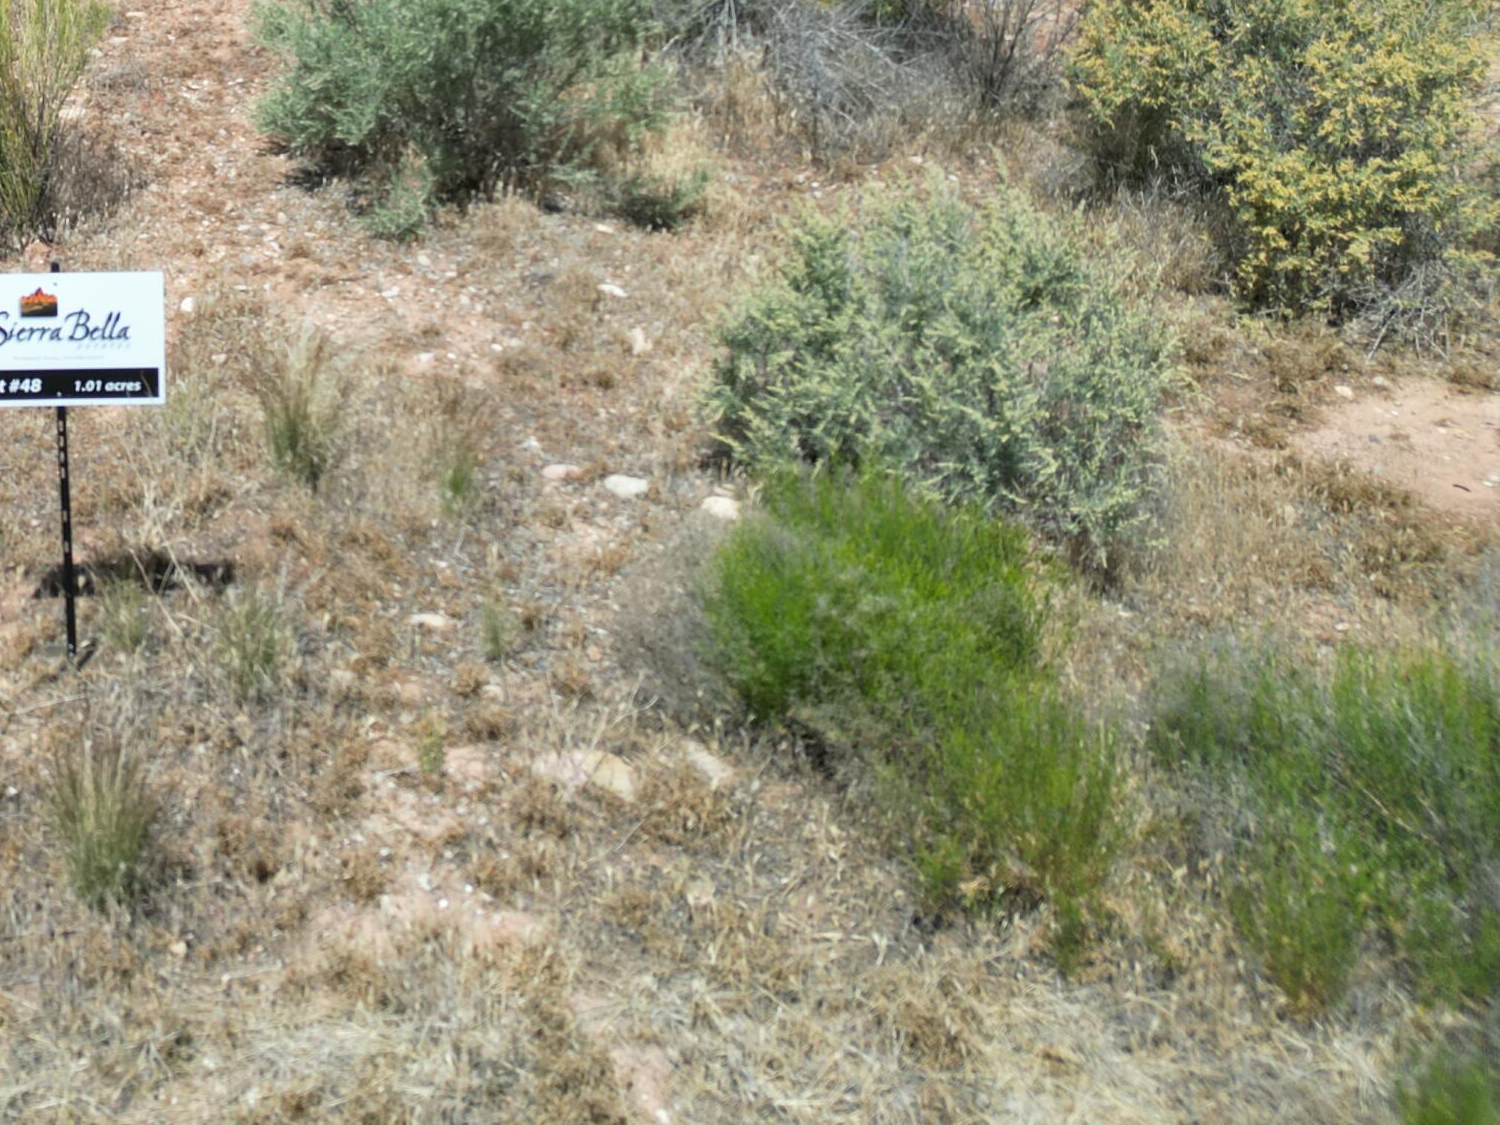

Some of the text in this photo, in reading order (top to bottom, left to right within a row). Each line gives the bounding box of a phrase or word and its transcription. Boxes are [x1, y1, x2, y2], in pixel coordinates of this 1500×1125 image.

[64, 308, 131, 342] Bella
[8, 378, 43, 392] #48
[74, 380, 102, 392] 1.01
[104, 381, 142, 392] acres
